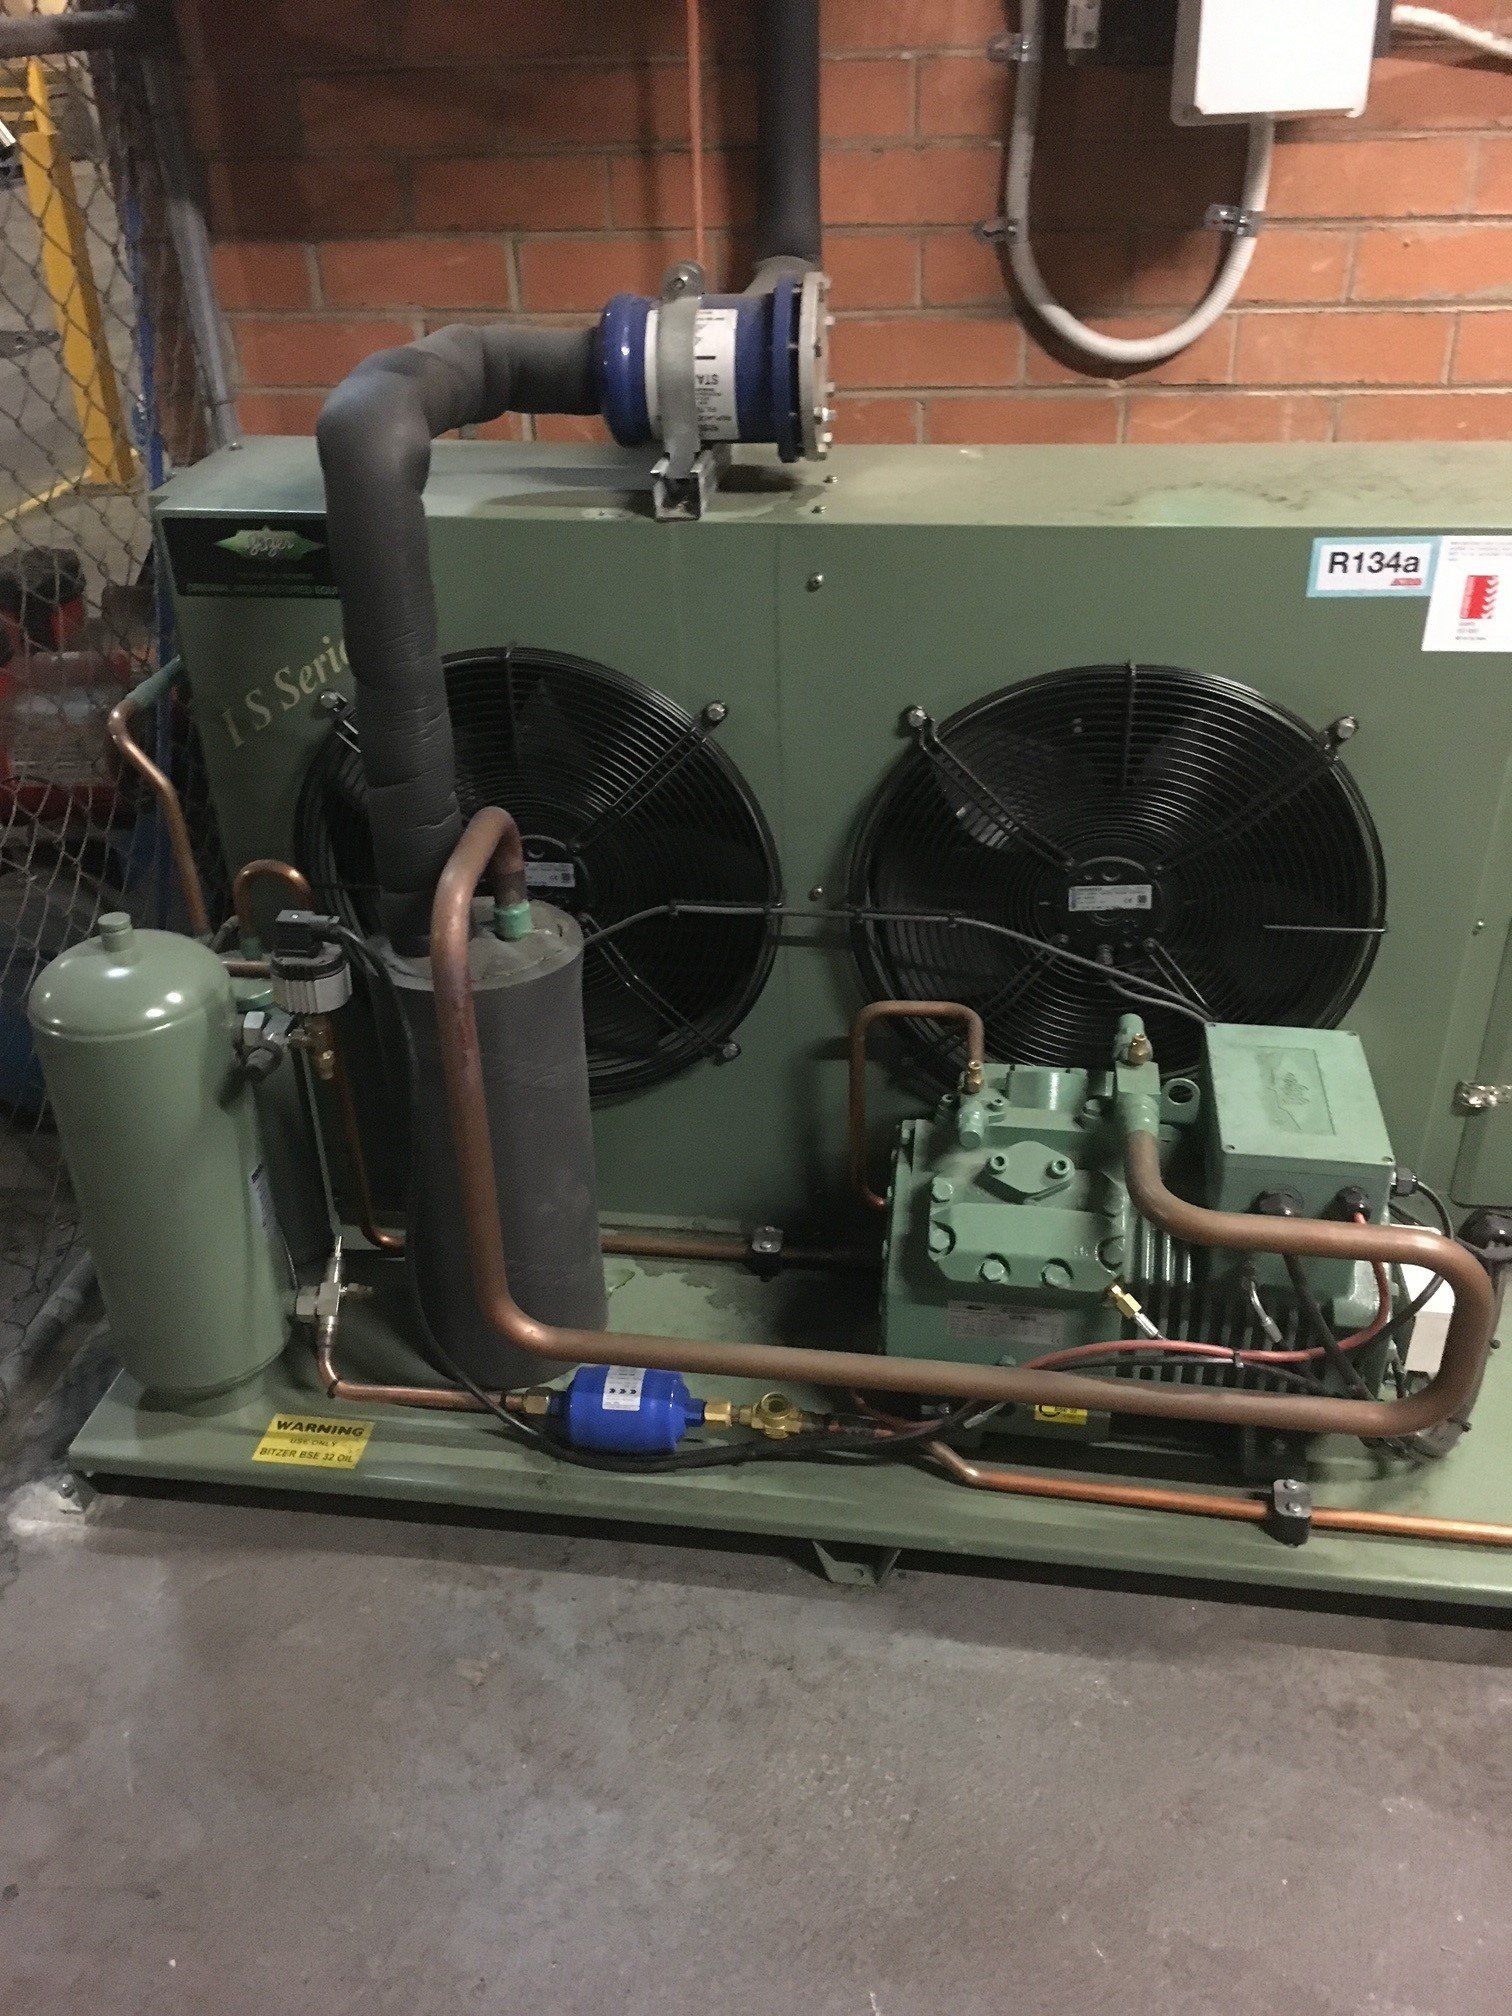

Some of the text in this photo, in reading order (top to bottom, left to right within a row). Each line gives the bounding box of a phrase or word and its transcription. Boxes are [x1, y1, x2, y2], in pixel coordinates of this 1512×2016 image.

[1327, 551, 1421, 574] R134a
[277, 1421, 365, 1437] WARNING
[311, 1440, 338, 1448] ONLY
[259, 1447, 353, 1462] BITZER BSE 32 OIL
